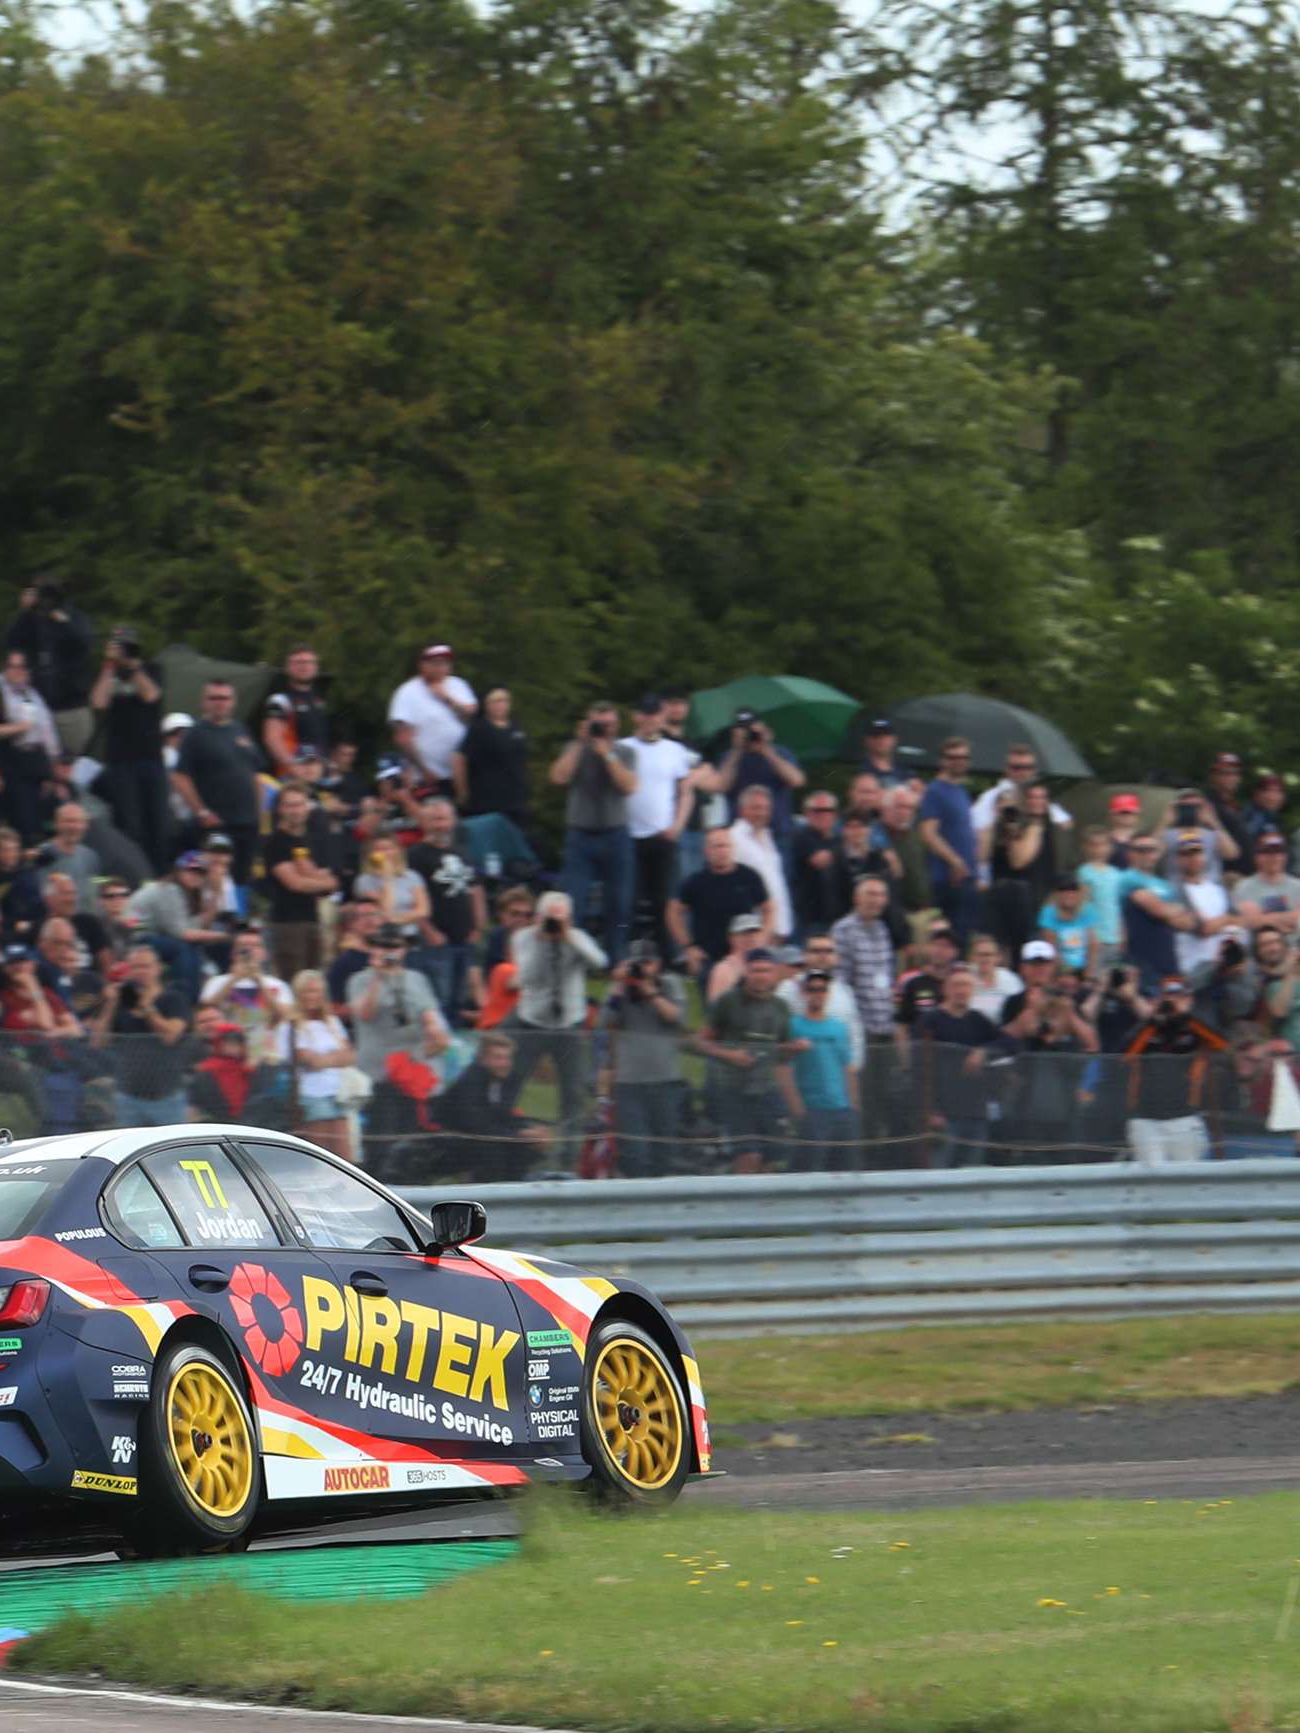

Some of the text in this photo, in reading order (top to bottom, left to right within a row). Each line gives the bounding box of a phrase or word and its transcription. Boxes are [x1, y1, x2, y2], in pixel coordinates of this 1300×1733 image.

[178, 1161, 229, 1209] 77
[55, 1227, 106, 1242] POPULOUS
[196, 1211, 264, 1239] Jordan
[302, 1275, 521, 1411] PIRTEK
[528, 1363, 549, 1377] OMP
[300, 1360, 513, 1446] 24/7 Hydraulic Service
[531, 1409, 579, 1424] PHYSICAL
[538, 1424, 575, 1438] DIGITAL
[84, 1476, 136, 1490] DUNLOP
[325, 1466, 390, 1490] AUTOCAR
